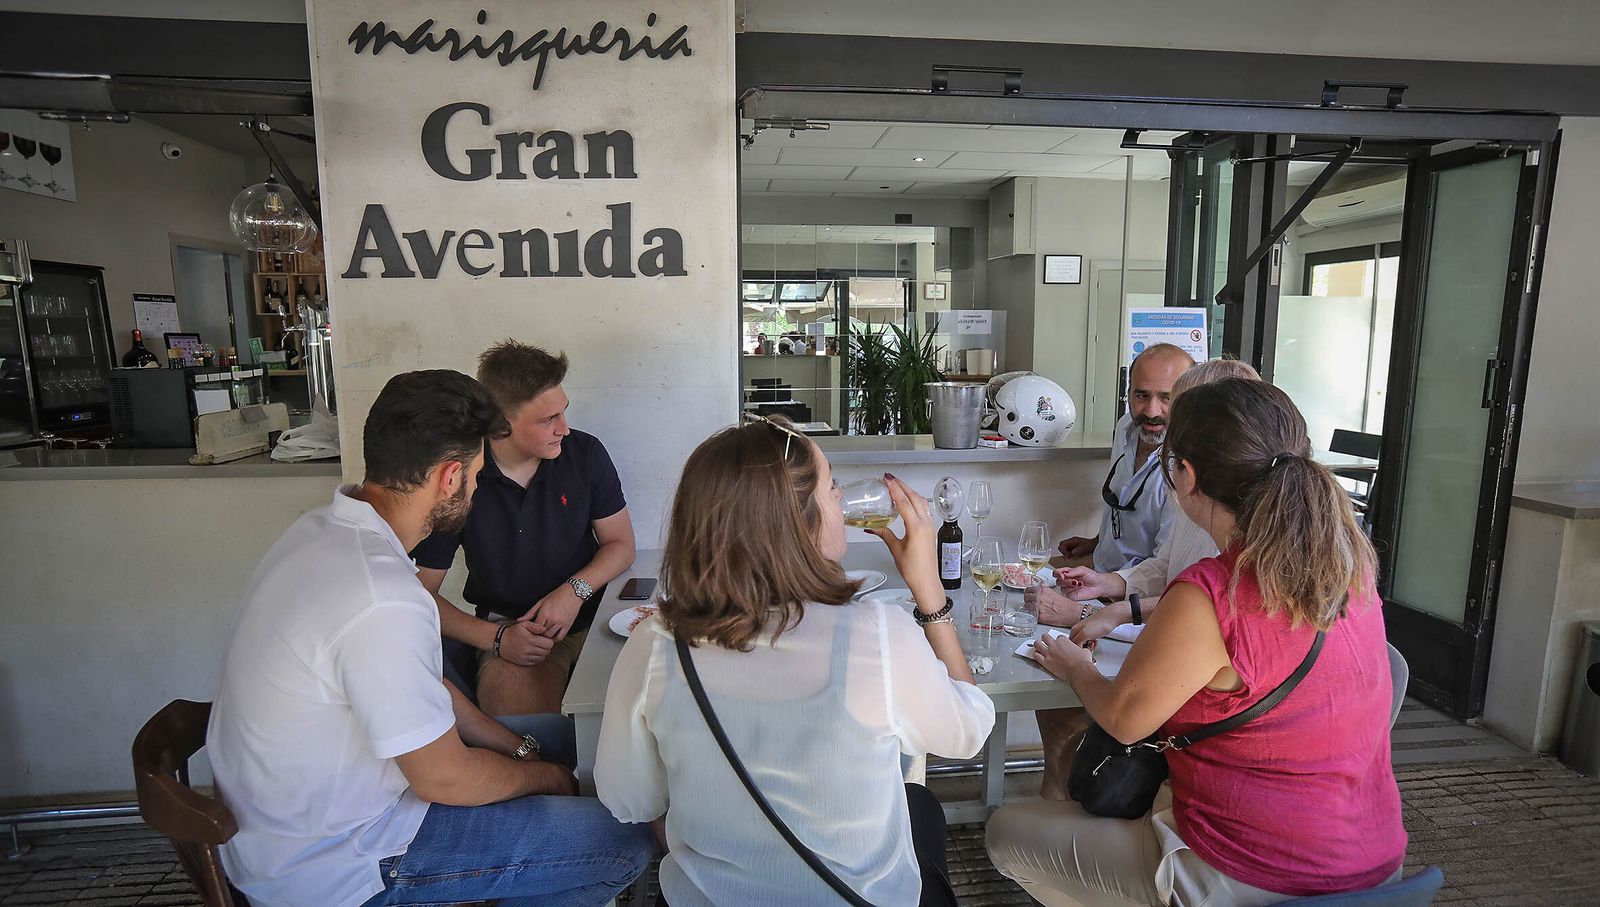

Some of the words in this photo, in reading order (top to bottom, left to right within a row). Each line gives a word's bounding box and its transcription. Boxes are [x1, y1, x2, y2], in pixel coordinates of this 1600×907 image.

[347, 9, 693, 90] marisqueria
[421, 101, 638, 181] Gran
[340, 201, 688, 279] Avenida
